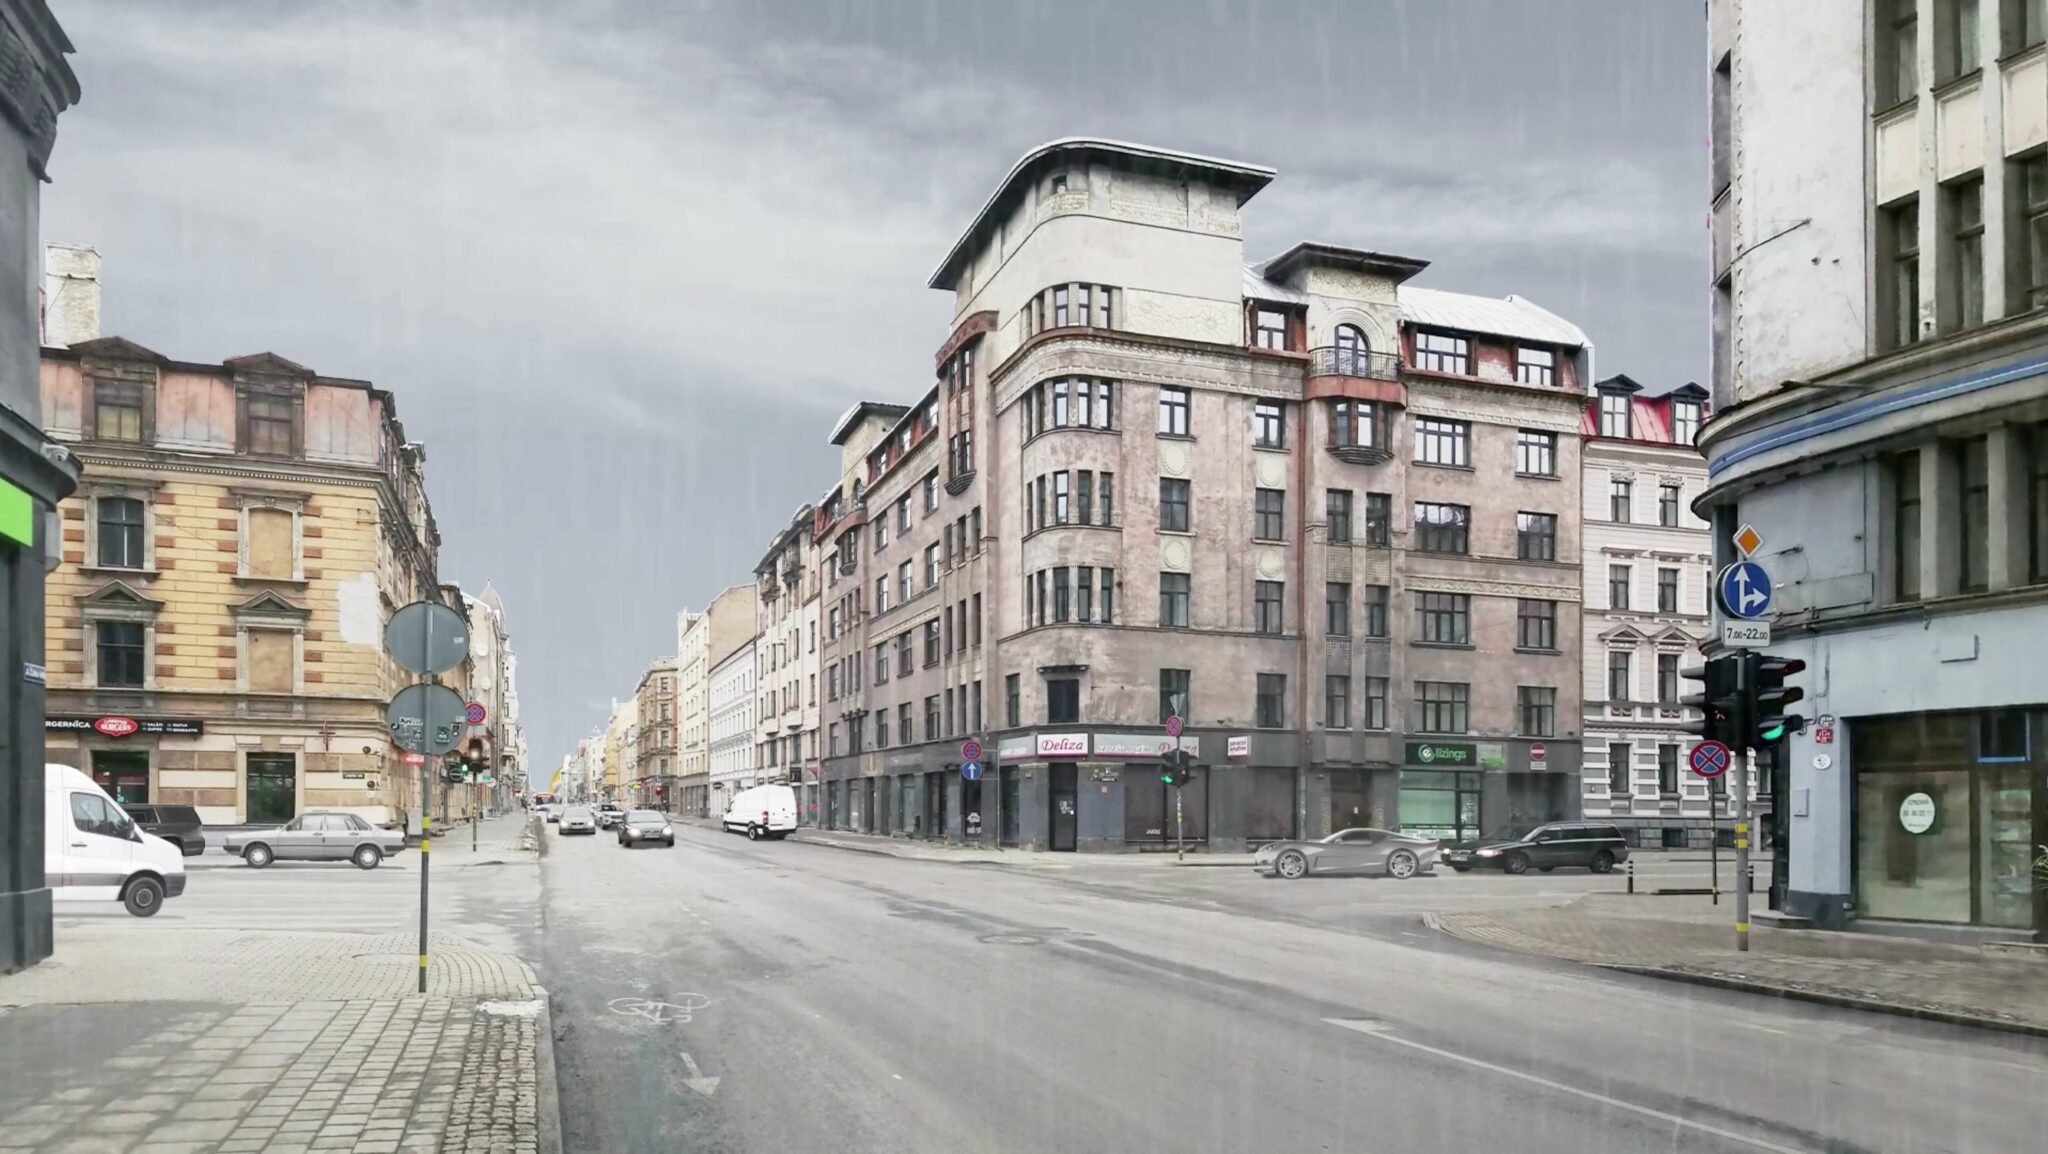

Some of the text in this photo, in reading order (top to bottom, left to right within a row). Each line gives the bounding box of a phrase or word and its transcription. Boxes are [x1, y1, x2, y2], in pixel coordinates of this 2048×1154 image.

[1727, 627, 1768, 640] 7.00-22.00
[1041, 738, 1084, 751] Deliza
[1435, 747, 1467, 762] lizings
